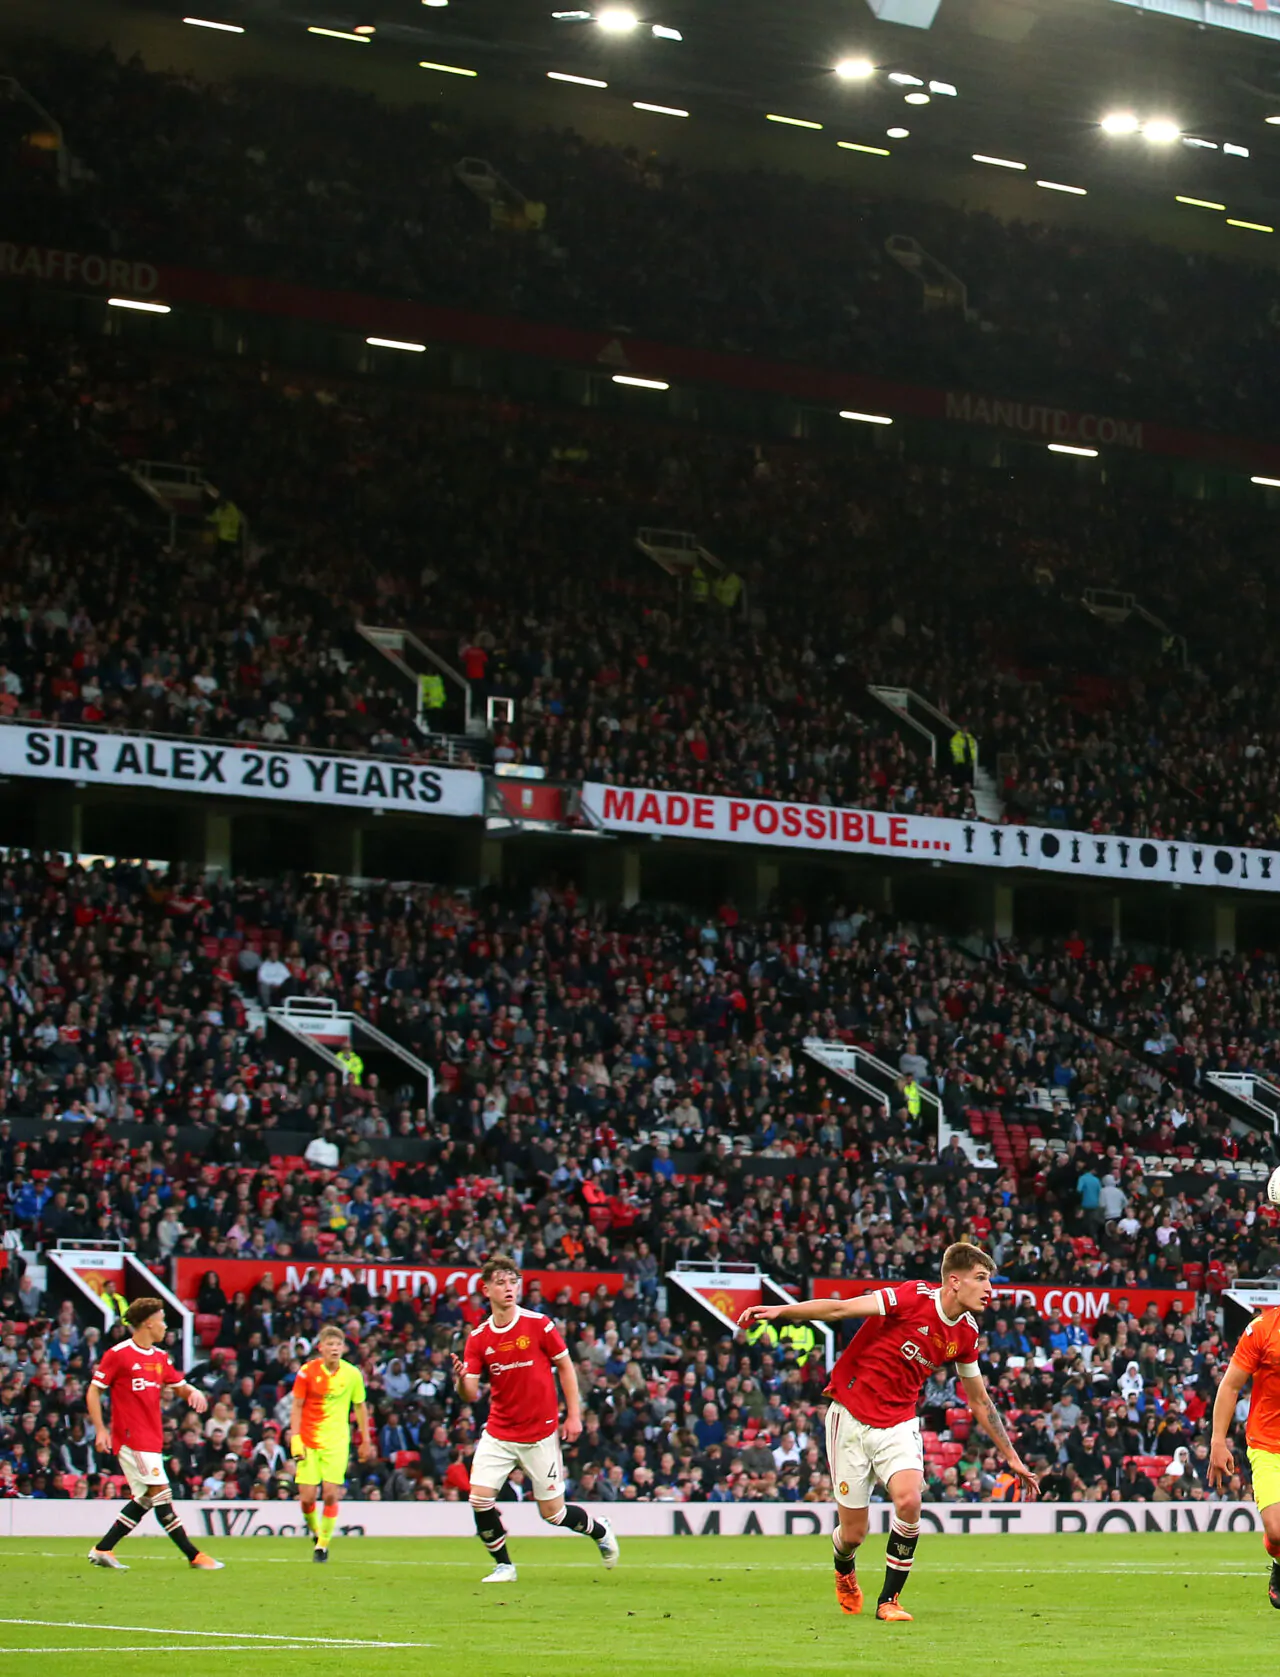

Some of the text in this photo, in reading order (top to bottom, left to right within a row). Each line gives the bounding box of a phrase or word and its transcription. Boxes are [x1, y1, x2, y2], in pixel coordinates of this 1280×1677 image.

[25, 732, 443, 803] SIR ALEX 26 YEARS
[604, 789, 714, 829] MADE
[547, 1461, 557, 1481] 4
